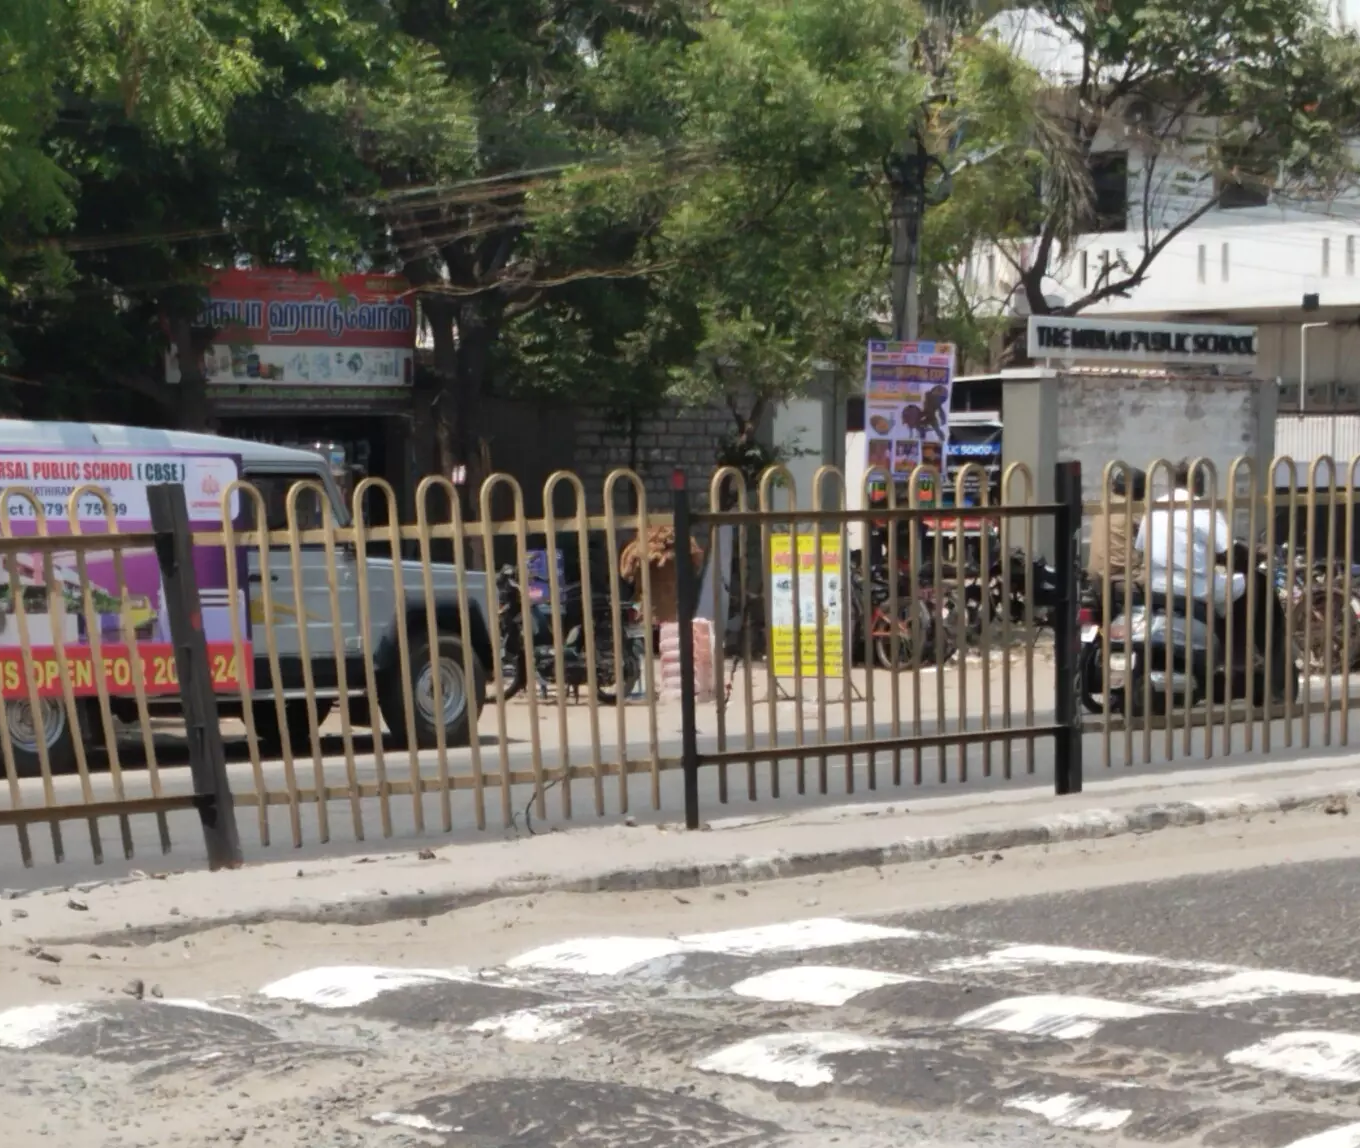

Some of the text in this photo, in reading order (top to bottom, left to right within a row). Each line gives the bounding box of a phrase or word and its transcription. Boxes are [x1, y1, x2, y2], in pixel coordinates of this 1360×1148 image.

[1037, 326, 1070, 347] THE
[1192, 333, 1256, 355] SCHOOL
[33, 462, 80, 480] PUBLIC
[83, 462, 134, 481] SCHOOL
